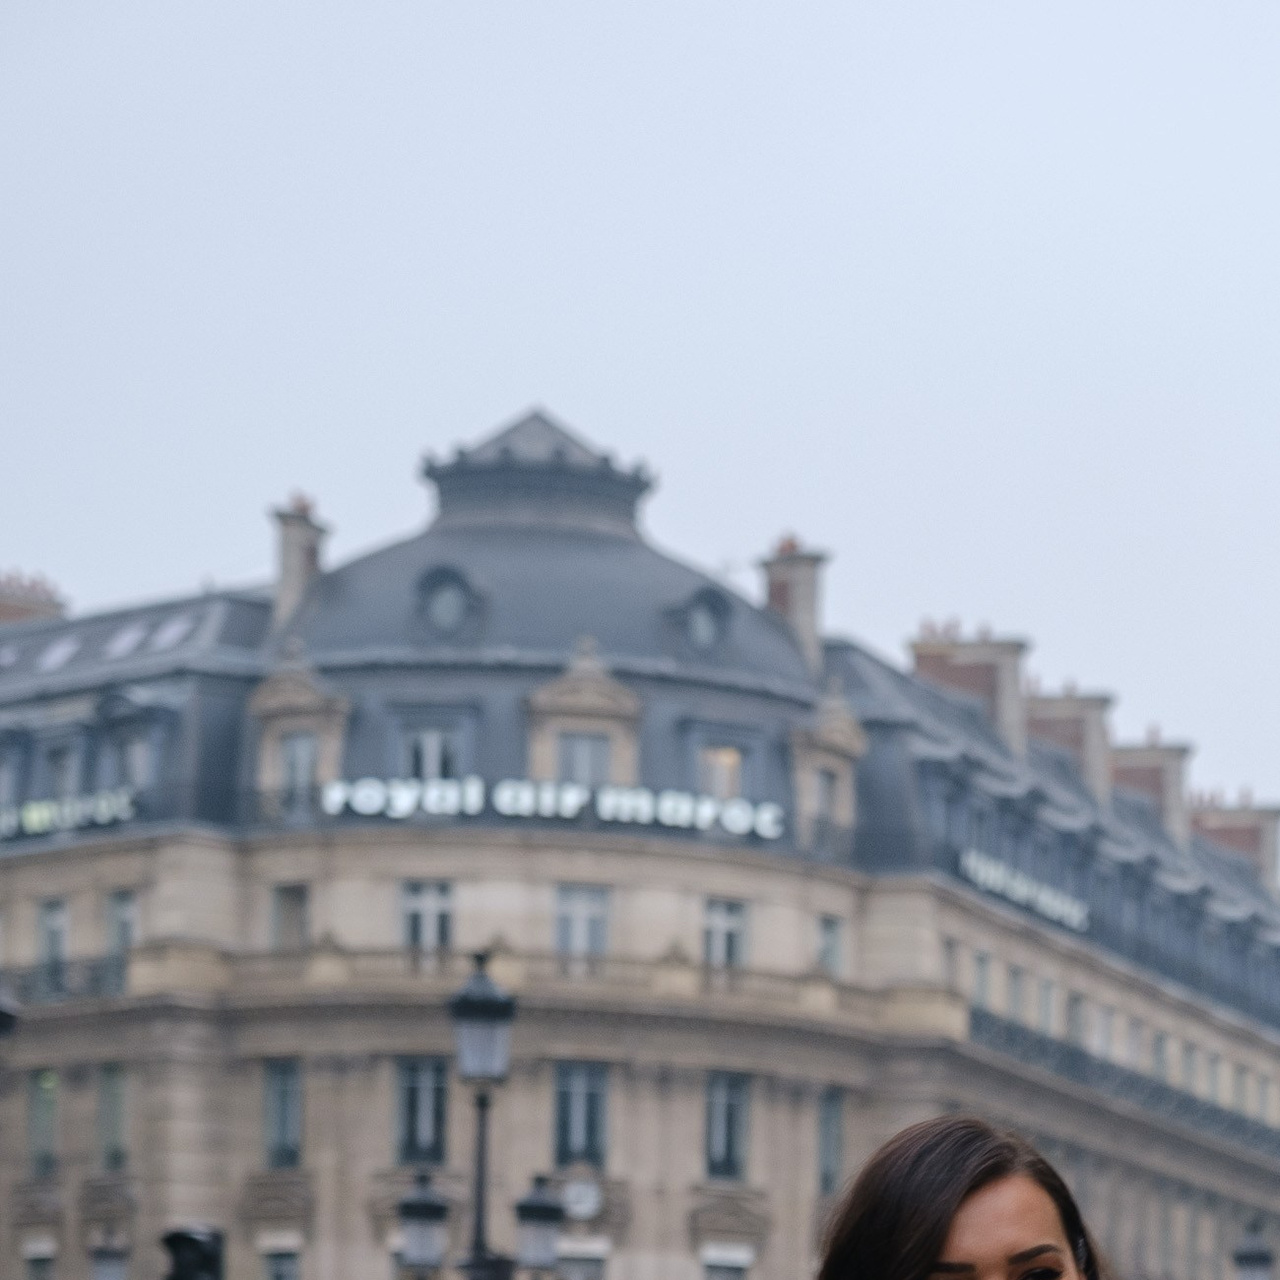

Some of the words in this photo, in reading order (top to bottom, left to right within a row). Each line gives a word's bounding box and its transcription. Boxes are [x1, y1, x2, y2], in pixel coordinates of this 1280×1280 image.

[322, 775, 485, 819] royal
[493, 778, 590, 819] air
[596, 786, 785, 840] maroc
